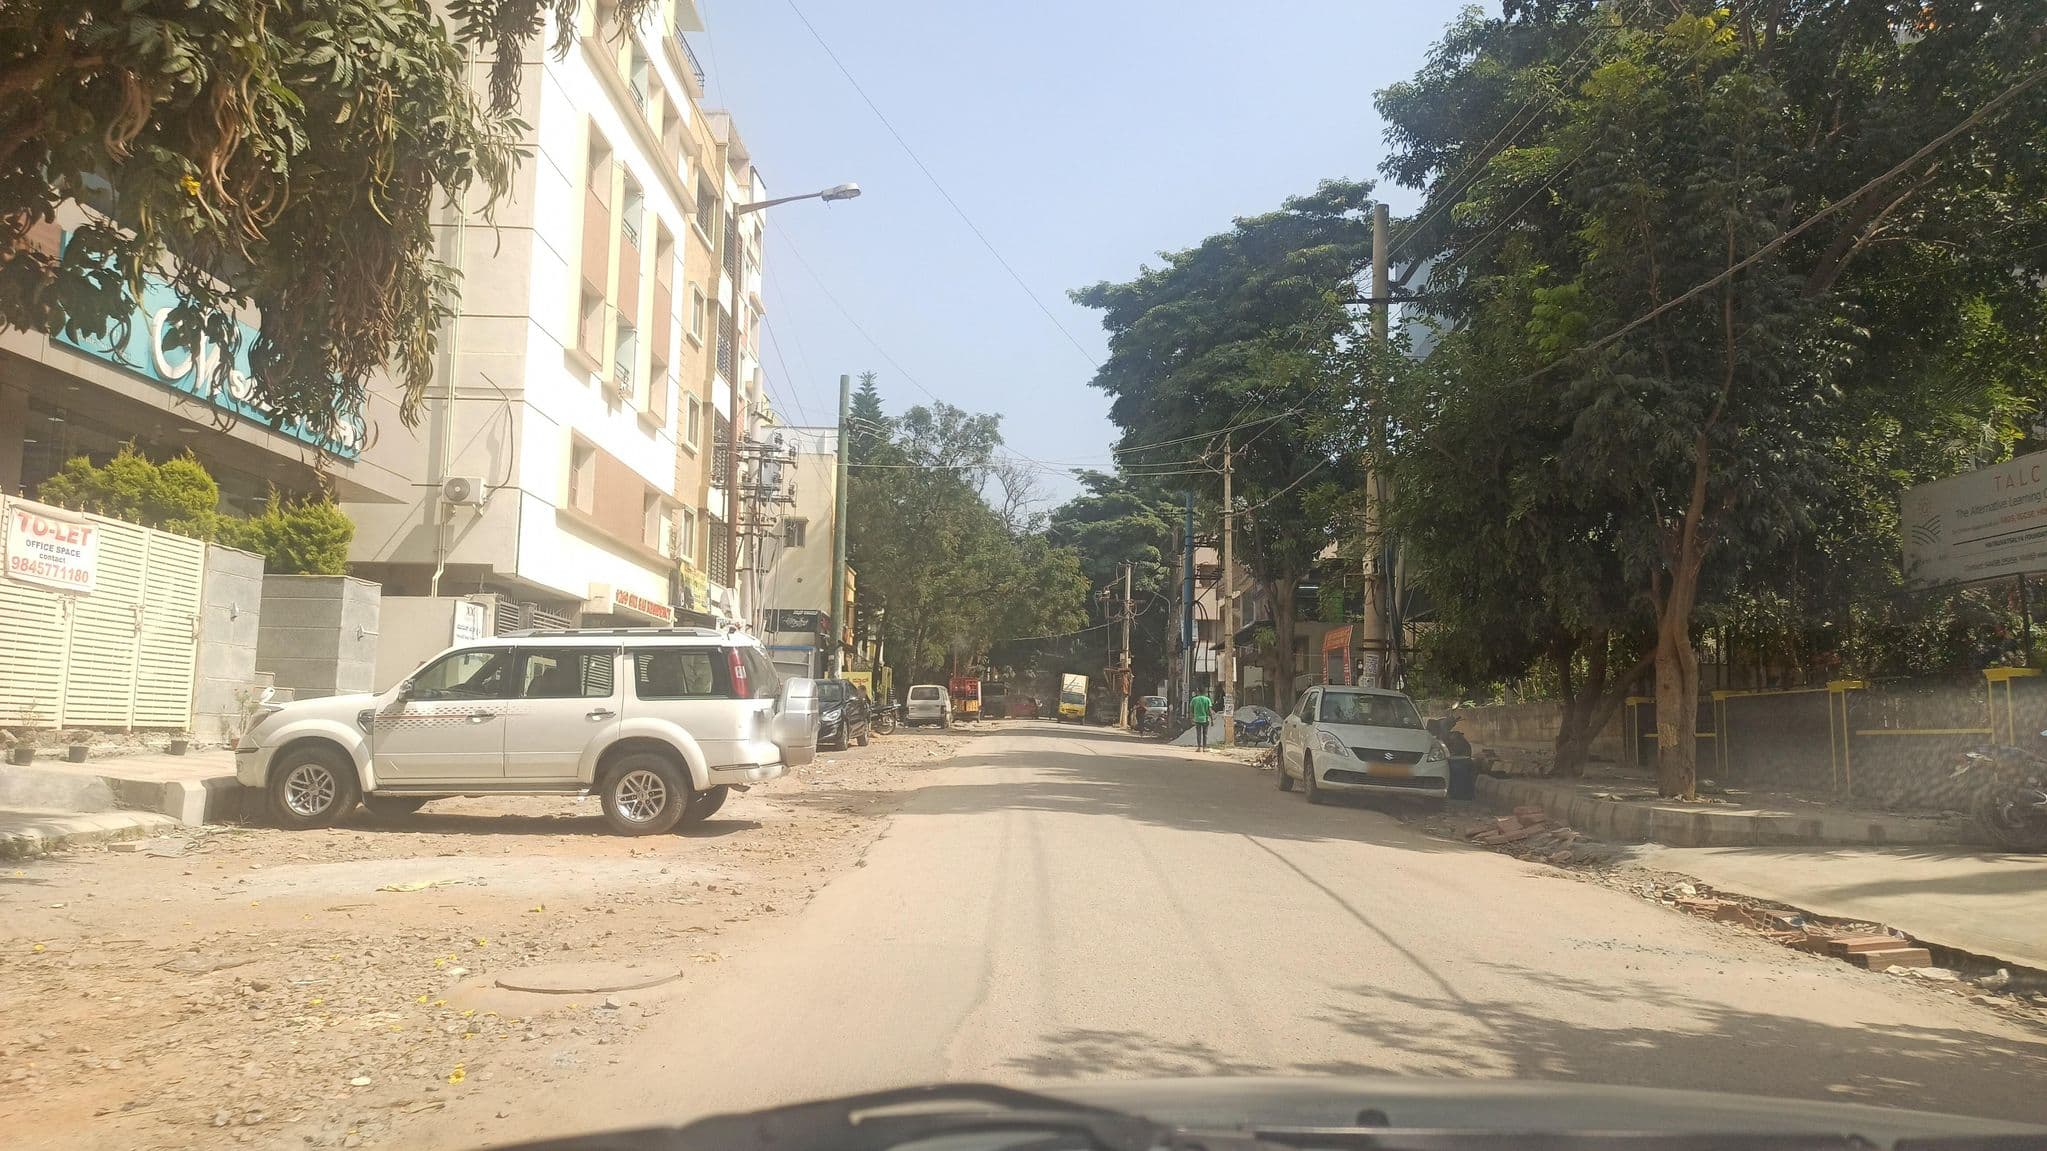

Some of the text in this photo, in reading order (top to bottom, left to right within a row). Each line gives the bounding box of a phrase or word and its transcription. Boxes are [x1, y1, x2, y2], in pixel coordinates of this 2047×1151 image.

[1993, 465, 2041, 492] TALC
[2009, 491, 2041, 507] Learning
[17, 511, 92, 546] TO-LET
[25, 539, 81, 558] OFFICE SPACE
[39, 553, 66, 564] contact
[11, 556, 89, 583] 9845771180
